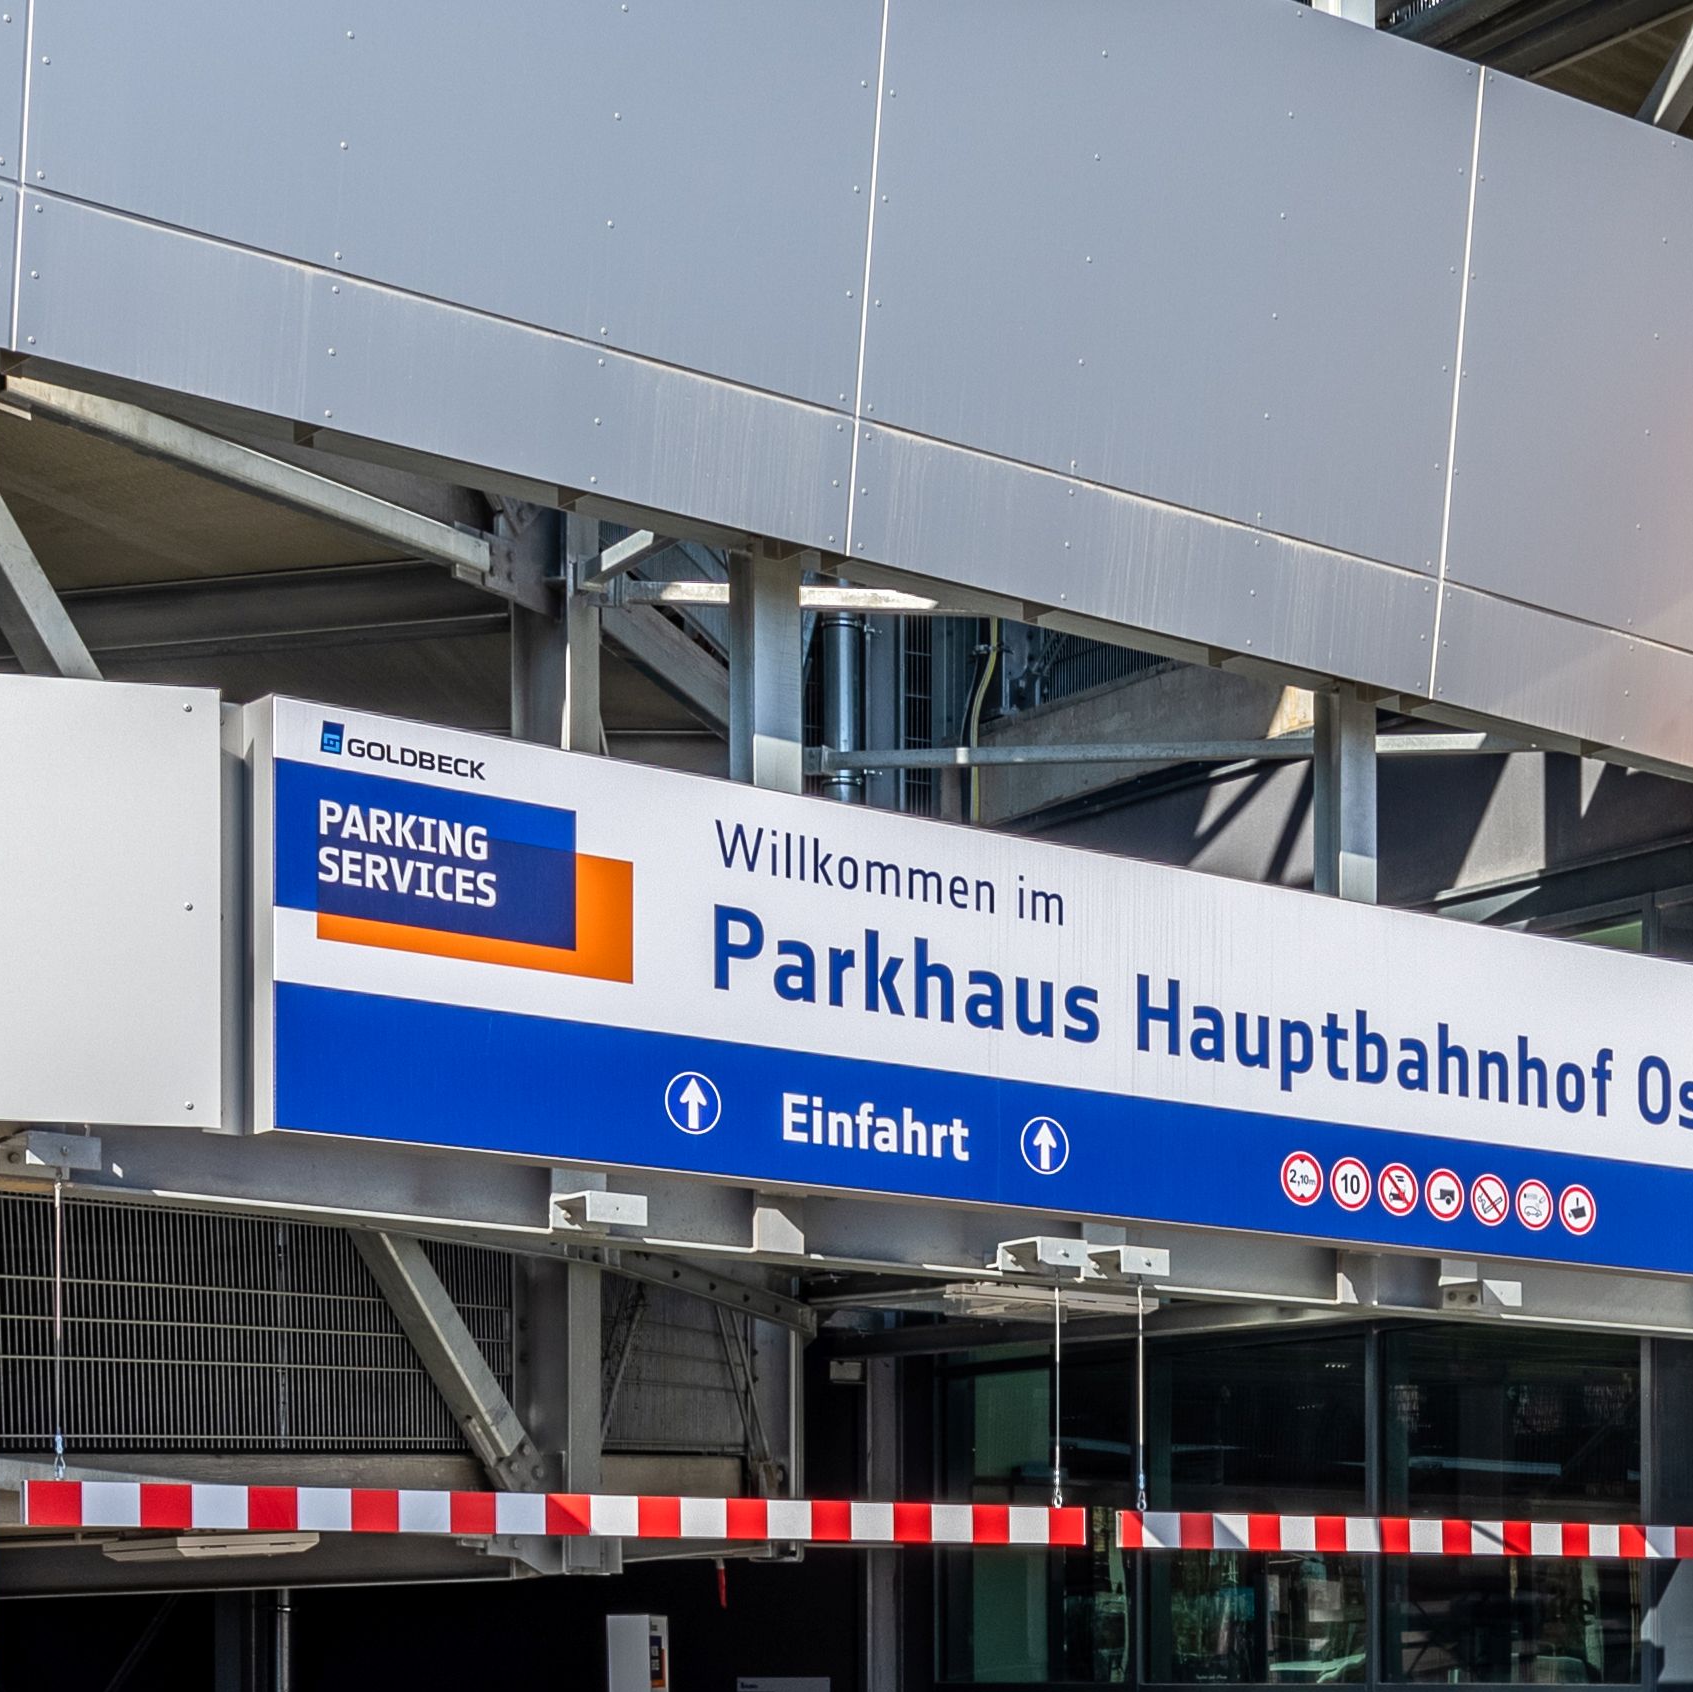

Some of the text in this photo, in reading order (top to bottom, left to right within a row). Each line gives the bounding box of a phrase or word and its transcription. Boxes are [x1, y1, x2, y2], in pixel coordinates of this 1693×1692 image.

[347, 737, 486, 781] GOLDBECK
[318, 800, 489, 862] PARKING
[317, 845, 498, 909] SERVICES
[715, 819, 1066, 927] Willkommen im
[714, 903, 1101, 1044] Parkhaus
[1136, 972, 1613, 1117] Hauptbahnhof
[781, 1092, 971, 1163] Einfahrt
[1289, 1168, 1316, 1187] 2,10m
[1340, 1173, 1360, 1195] 10
